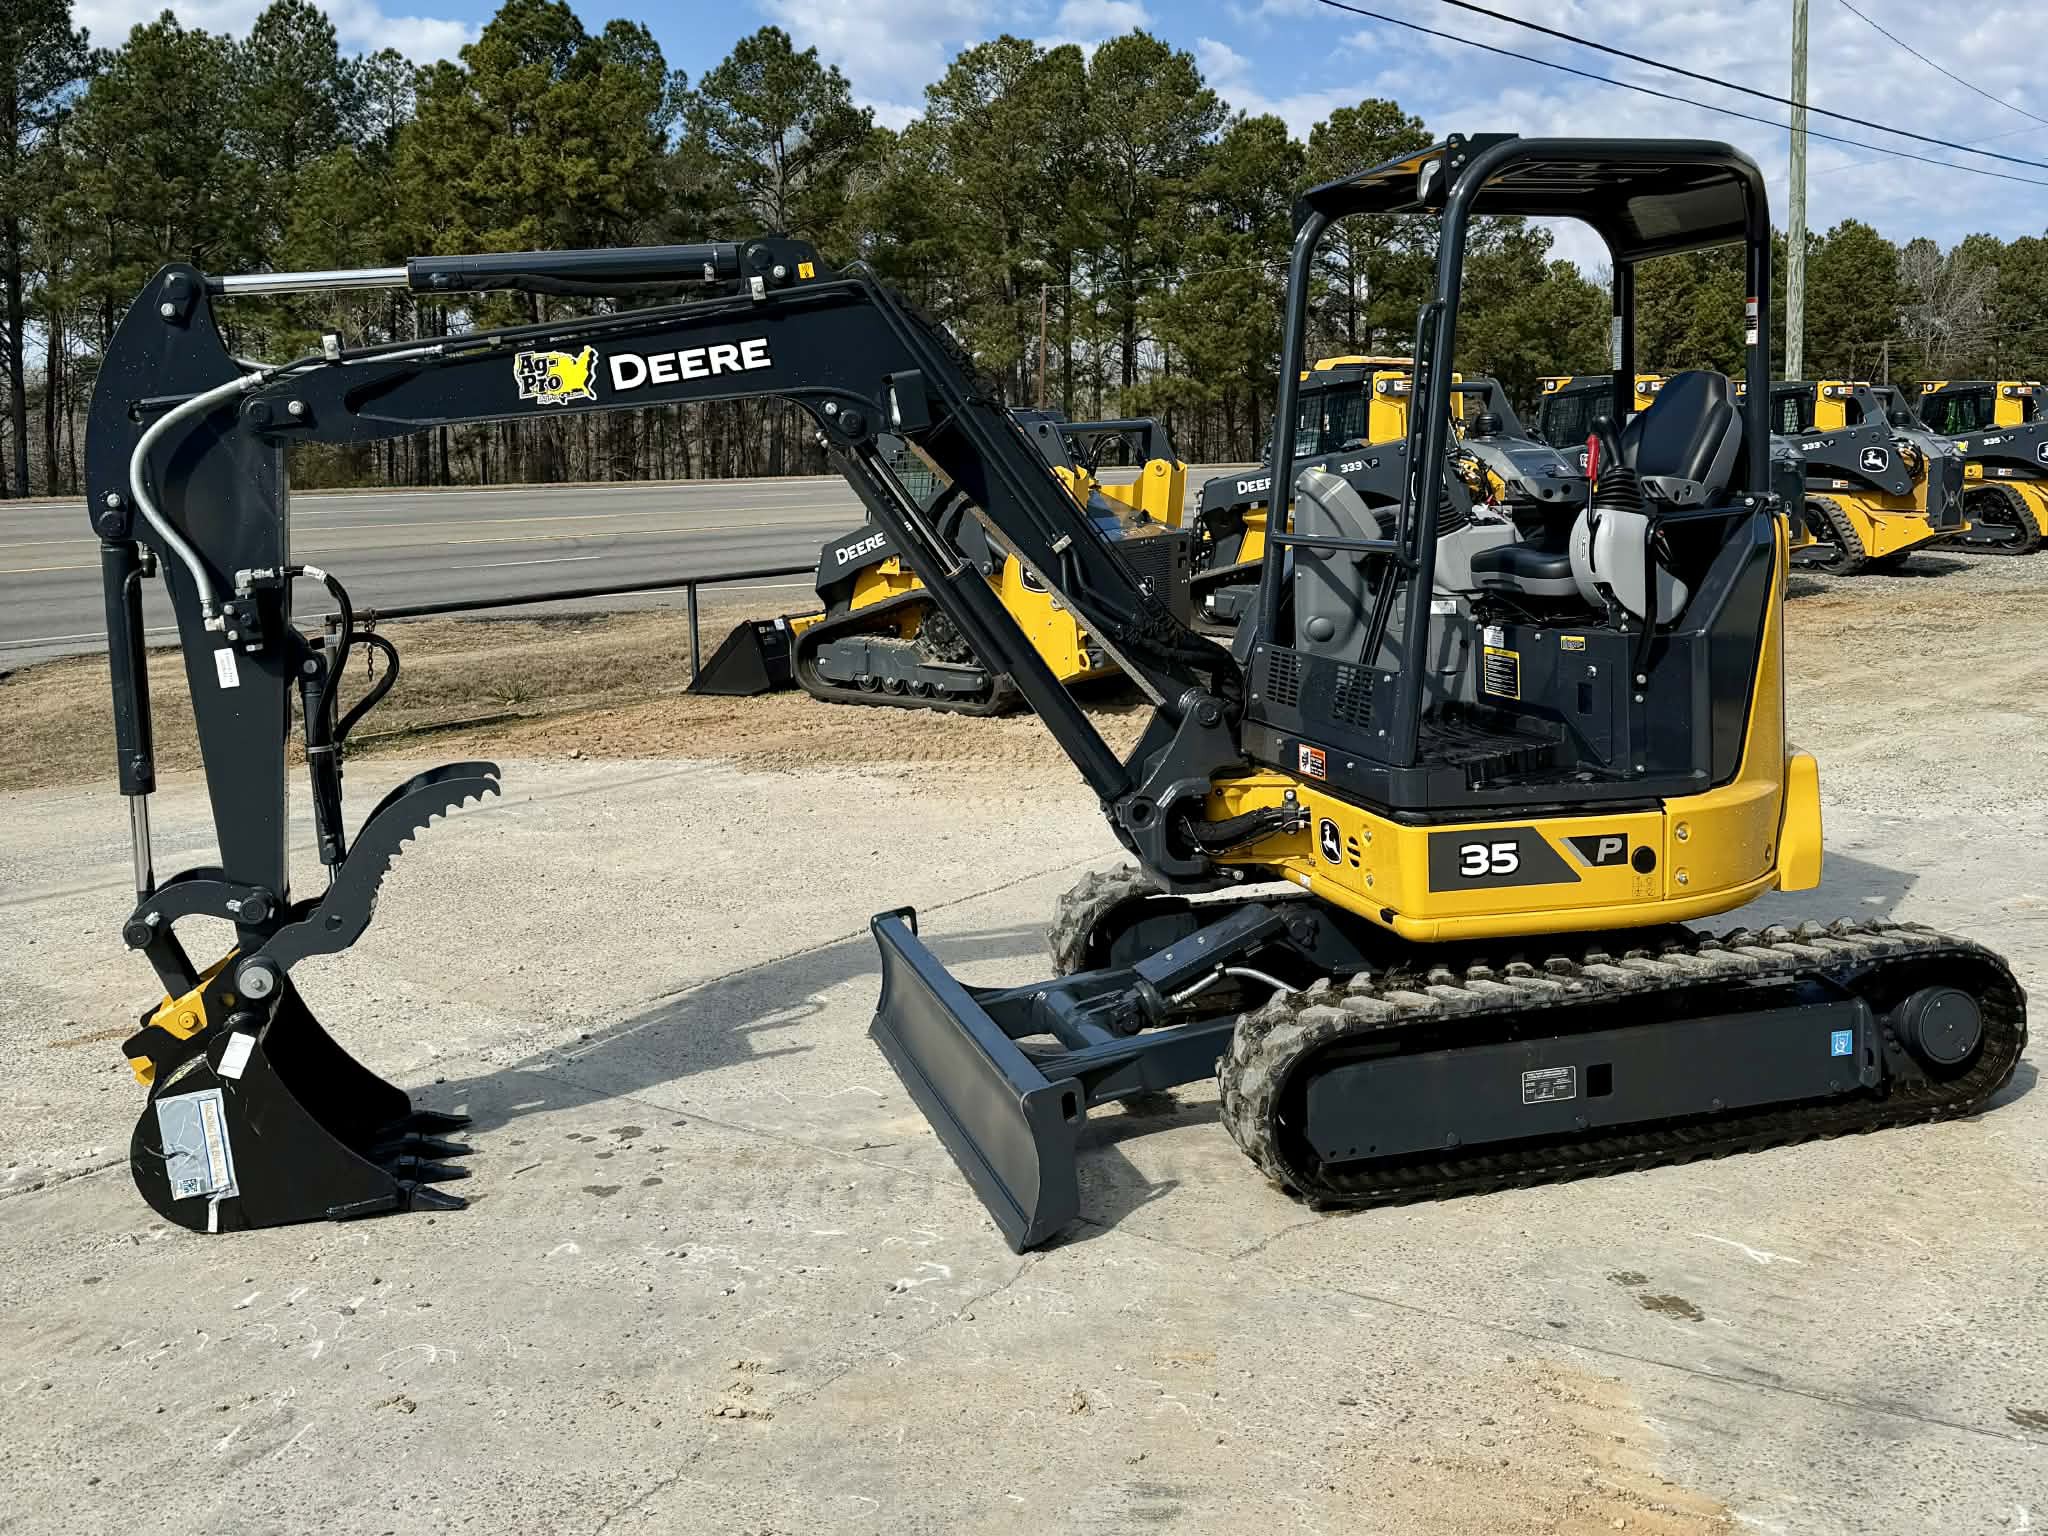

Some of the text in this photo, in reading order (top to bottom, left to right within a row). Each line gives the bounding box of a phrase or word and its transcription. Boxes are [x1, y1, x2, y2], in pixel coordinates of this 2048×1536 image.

[519, 354, 558, 377] Ag-
[609, 338, 772, 391] DEERE
[521, 373, 563, 395] Pro
[1340, 459, 1378, 473] 333 P
[835, 532, 886, 565] DEERE
[1460, 837, 1623, 877] 35 P
